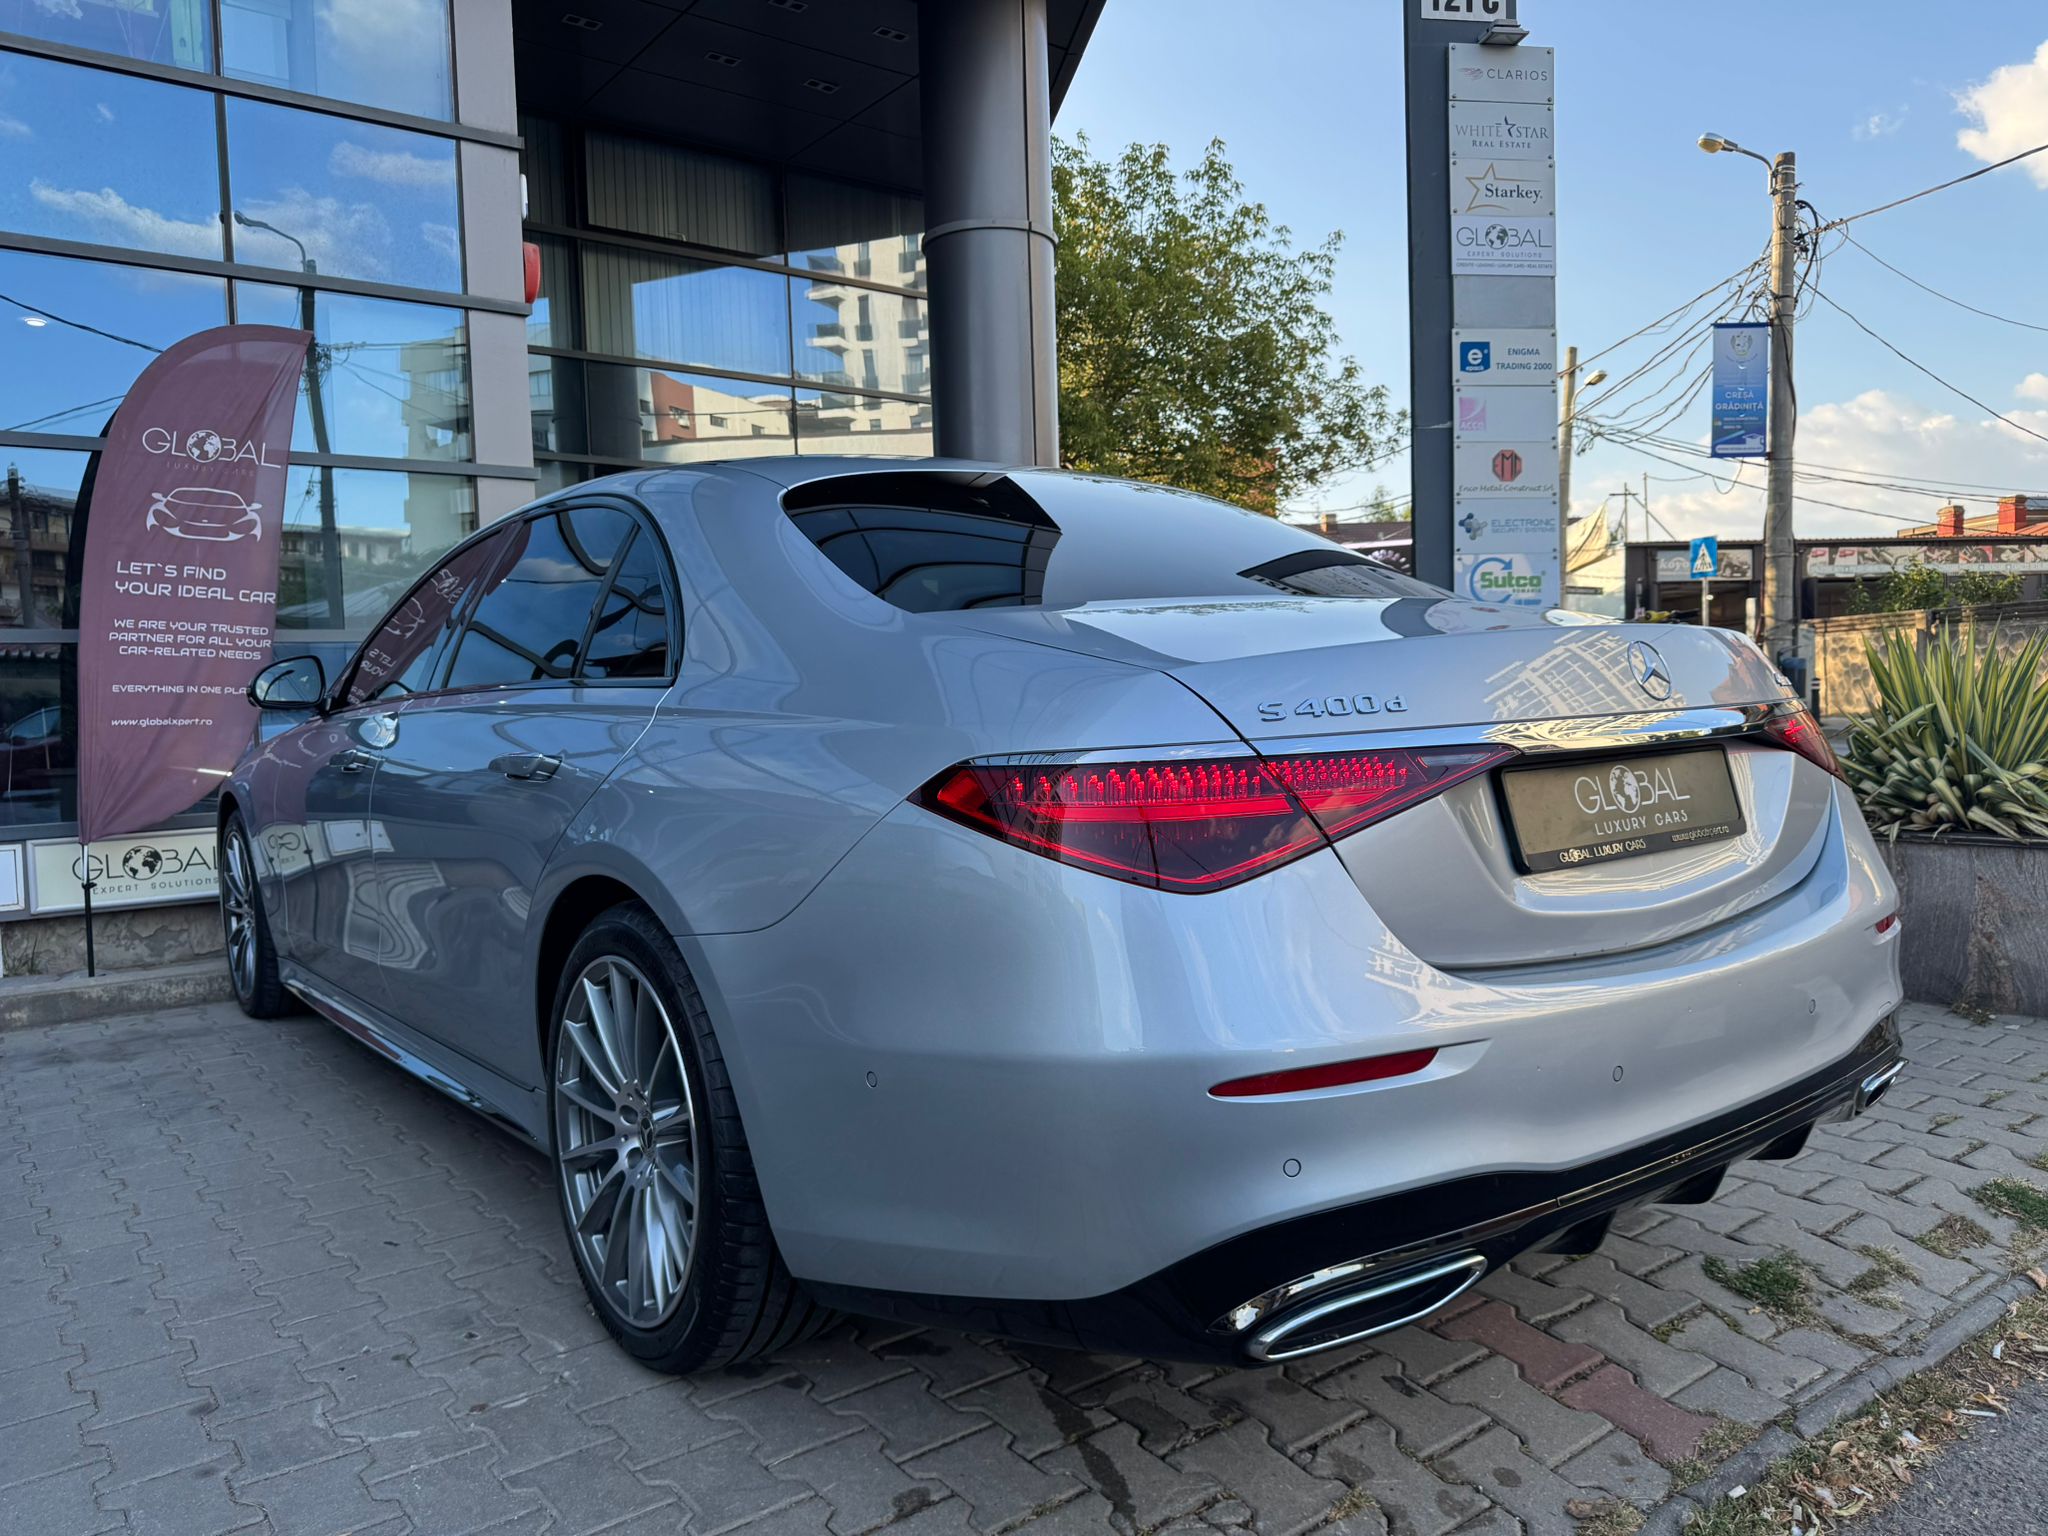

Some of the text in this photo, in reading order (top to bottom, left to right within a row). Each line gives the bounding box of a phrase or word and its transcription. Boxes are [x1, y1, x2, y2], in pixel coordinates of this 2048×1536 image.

[1486, 68, 1548, 81] CLARIOS
[1455, 123, 1550, 139] WHITE STAR
[1472, 140, 1531, 149] REAL ESTATE
[1456, 223, 1553, 250] GLOBAL
[1507, 347, 1540, 356] ENIGMA
[1496, 362, 1553, 371] TRADING 2000
[142, 427, 282, 468] GLOBAL
[1491, 518, 1556, 528] ELECTRONIC
[183, 565, 227, 581] FIND
[115, 580, 277, 604] YOUR IDEAL CAR
[114, 618, 269, 636] WE ARE YOUR TRUSTED
[108, 631, 272, 648] PARTNER FOR ALL YOUR
[119, 645, 262, 660] CAR-RELATED NEEDS
[112, 684, 184, 693] EVERYTHING
[187, 685, 198, 693] IN
[200, 686, 222, 694] ONE
[1257, 701, 1288, 722] S
[111, 717, 213, 728] www.globalxpert.ro
[1574, 764, 1691, 814] GLOBAL
[1594, 809, 1689, 836] LUXURY CARS
[1559, 838, 1646, 863] GLOBAL LUXURY CARS
[93, 884, 139, 896] EXPERT
